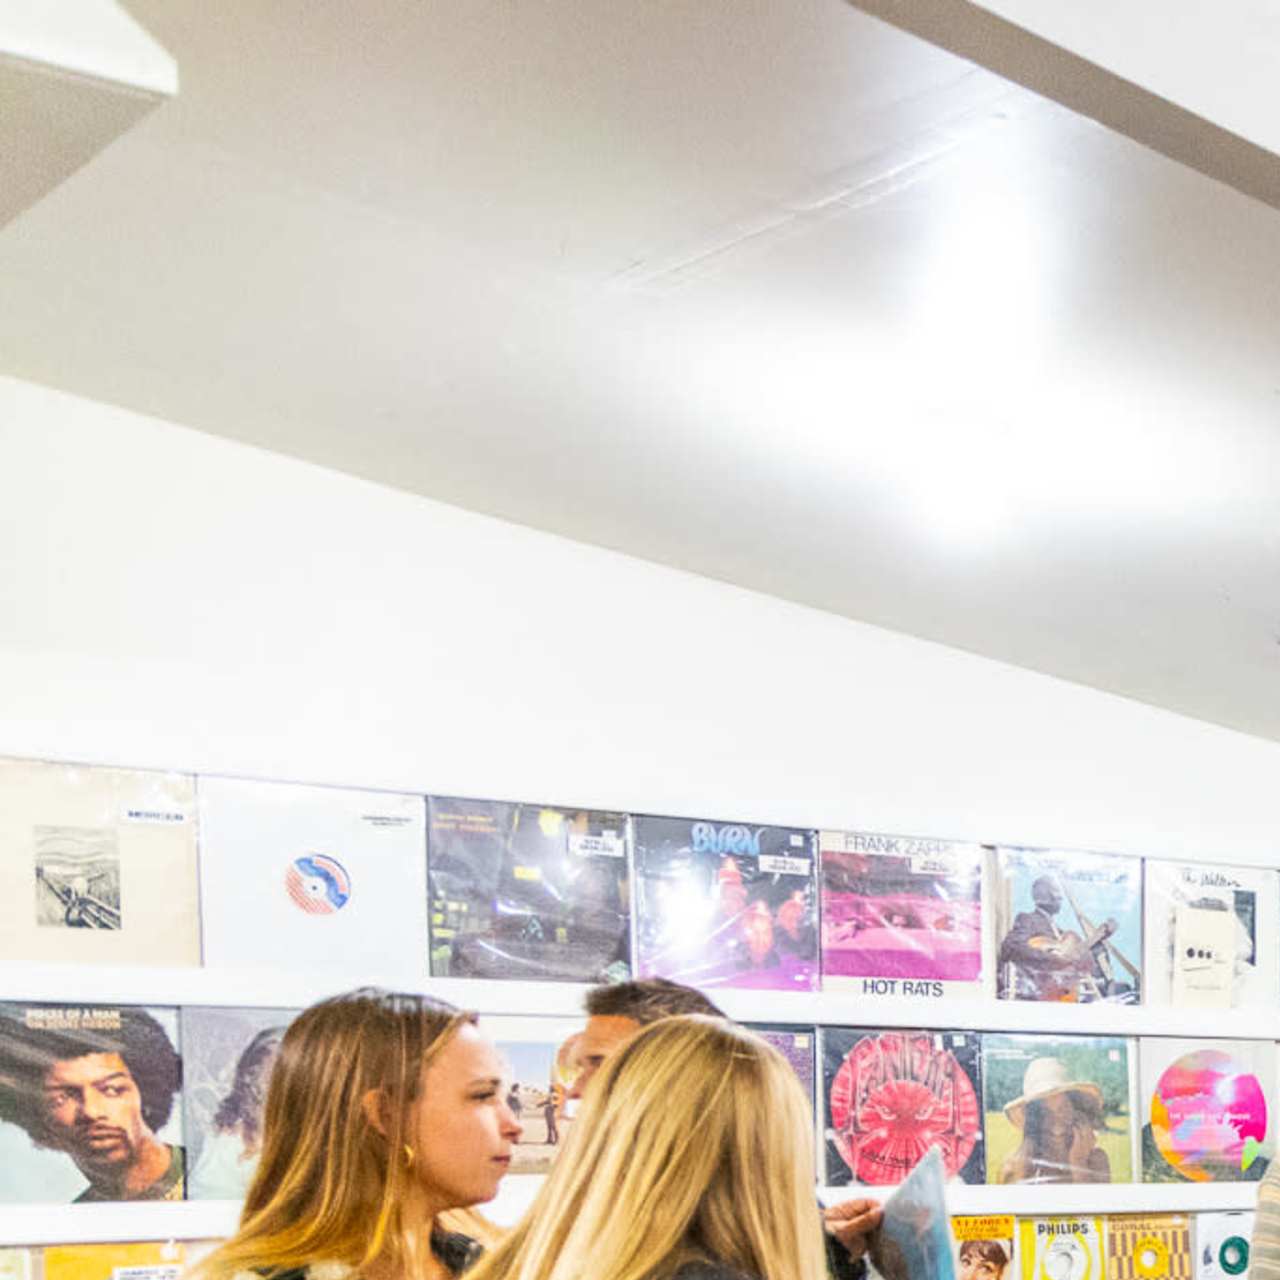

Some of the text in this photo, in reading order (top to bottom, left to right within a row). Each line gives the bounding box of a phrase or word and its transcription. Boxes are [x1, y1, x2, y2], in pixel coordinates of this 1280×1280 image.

[862, 980, 944, 998] HOT RATS
[1037, 1223, 1089, 1236] PHILIPS
